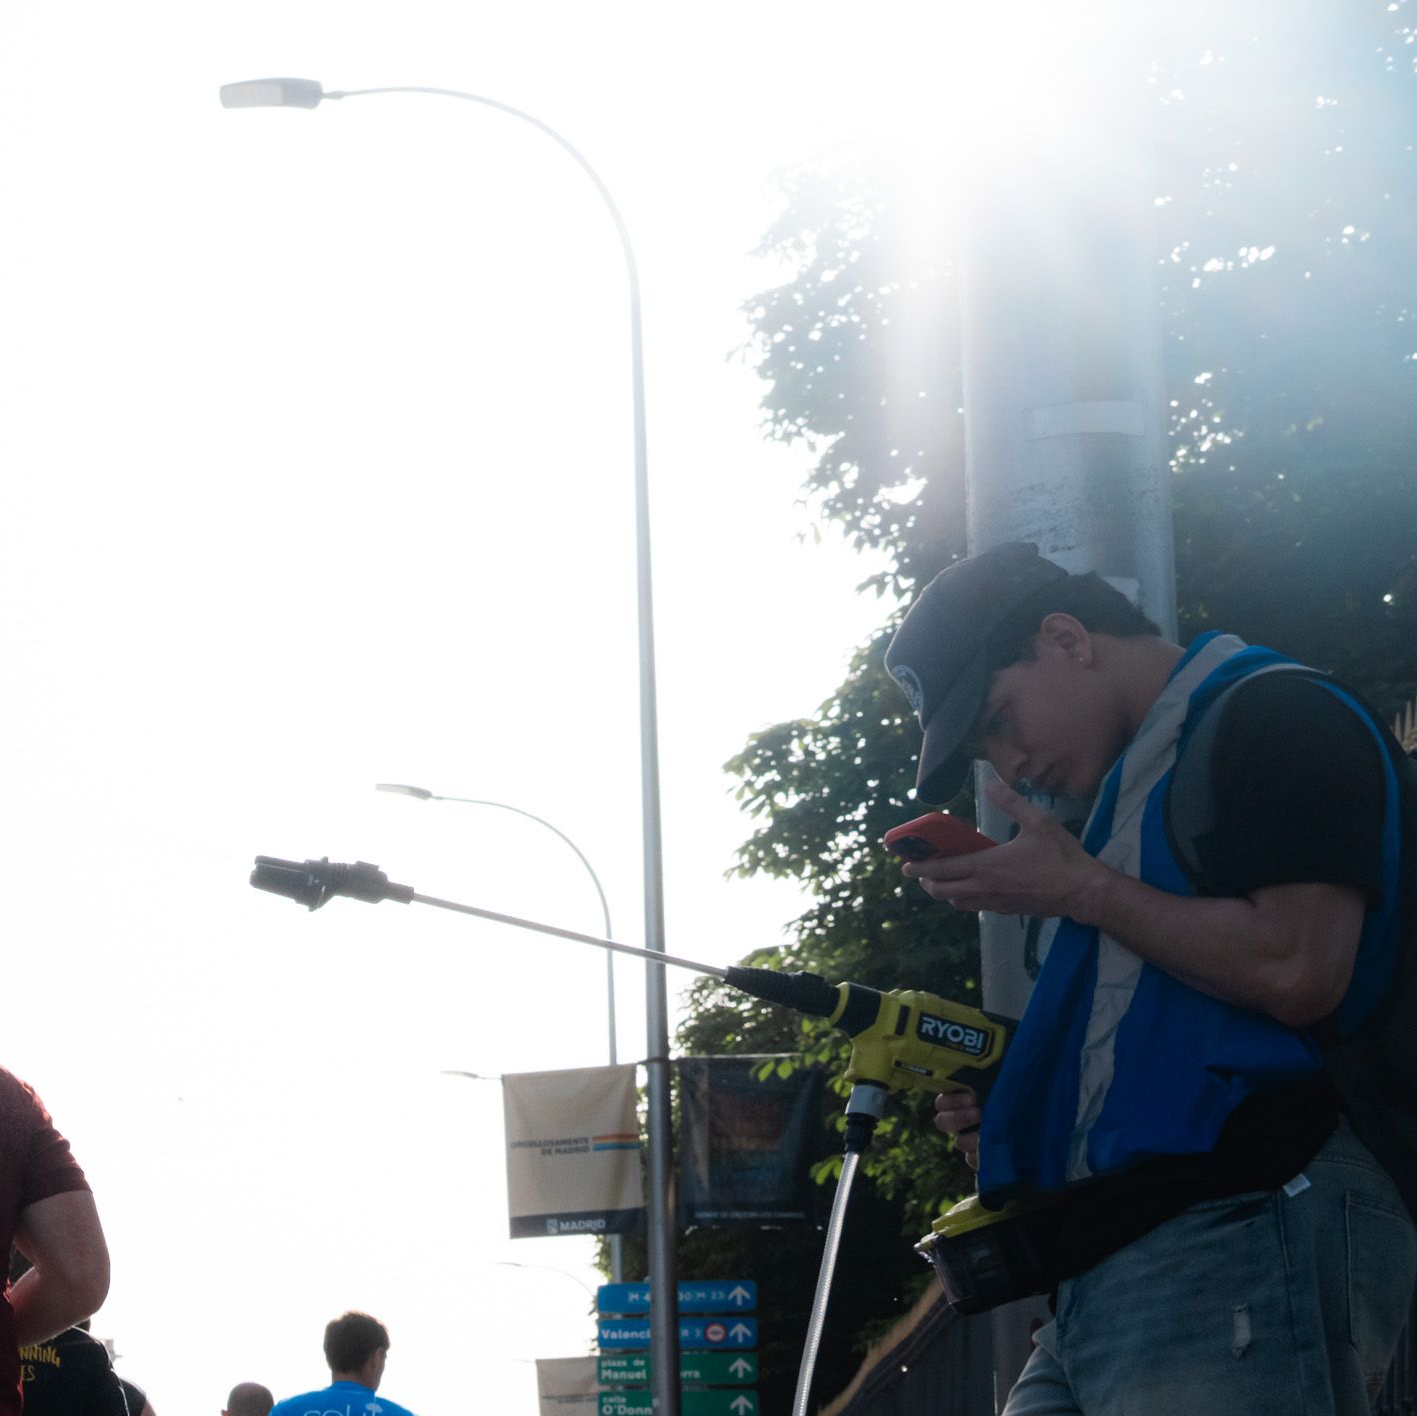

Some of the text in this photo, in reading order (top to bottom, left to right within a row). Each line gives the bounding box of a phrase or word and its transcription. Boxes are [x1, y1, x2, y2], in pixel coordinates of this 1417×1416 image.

[920, 1015, 985, 1049] RYOBI
[560, 1218, 606, 1232] MADRID
[601, 1369, 647, 1380] Manuel
